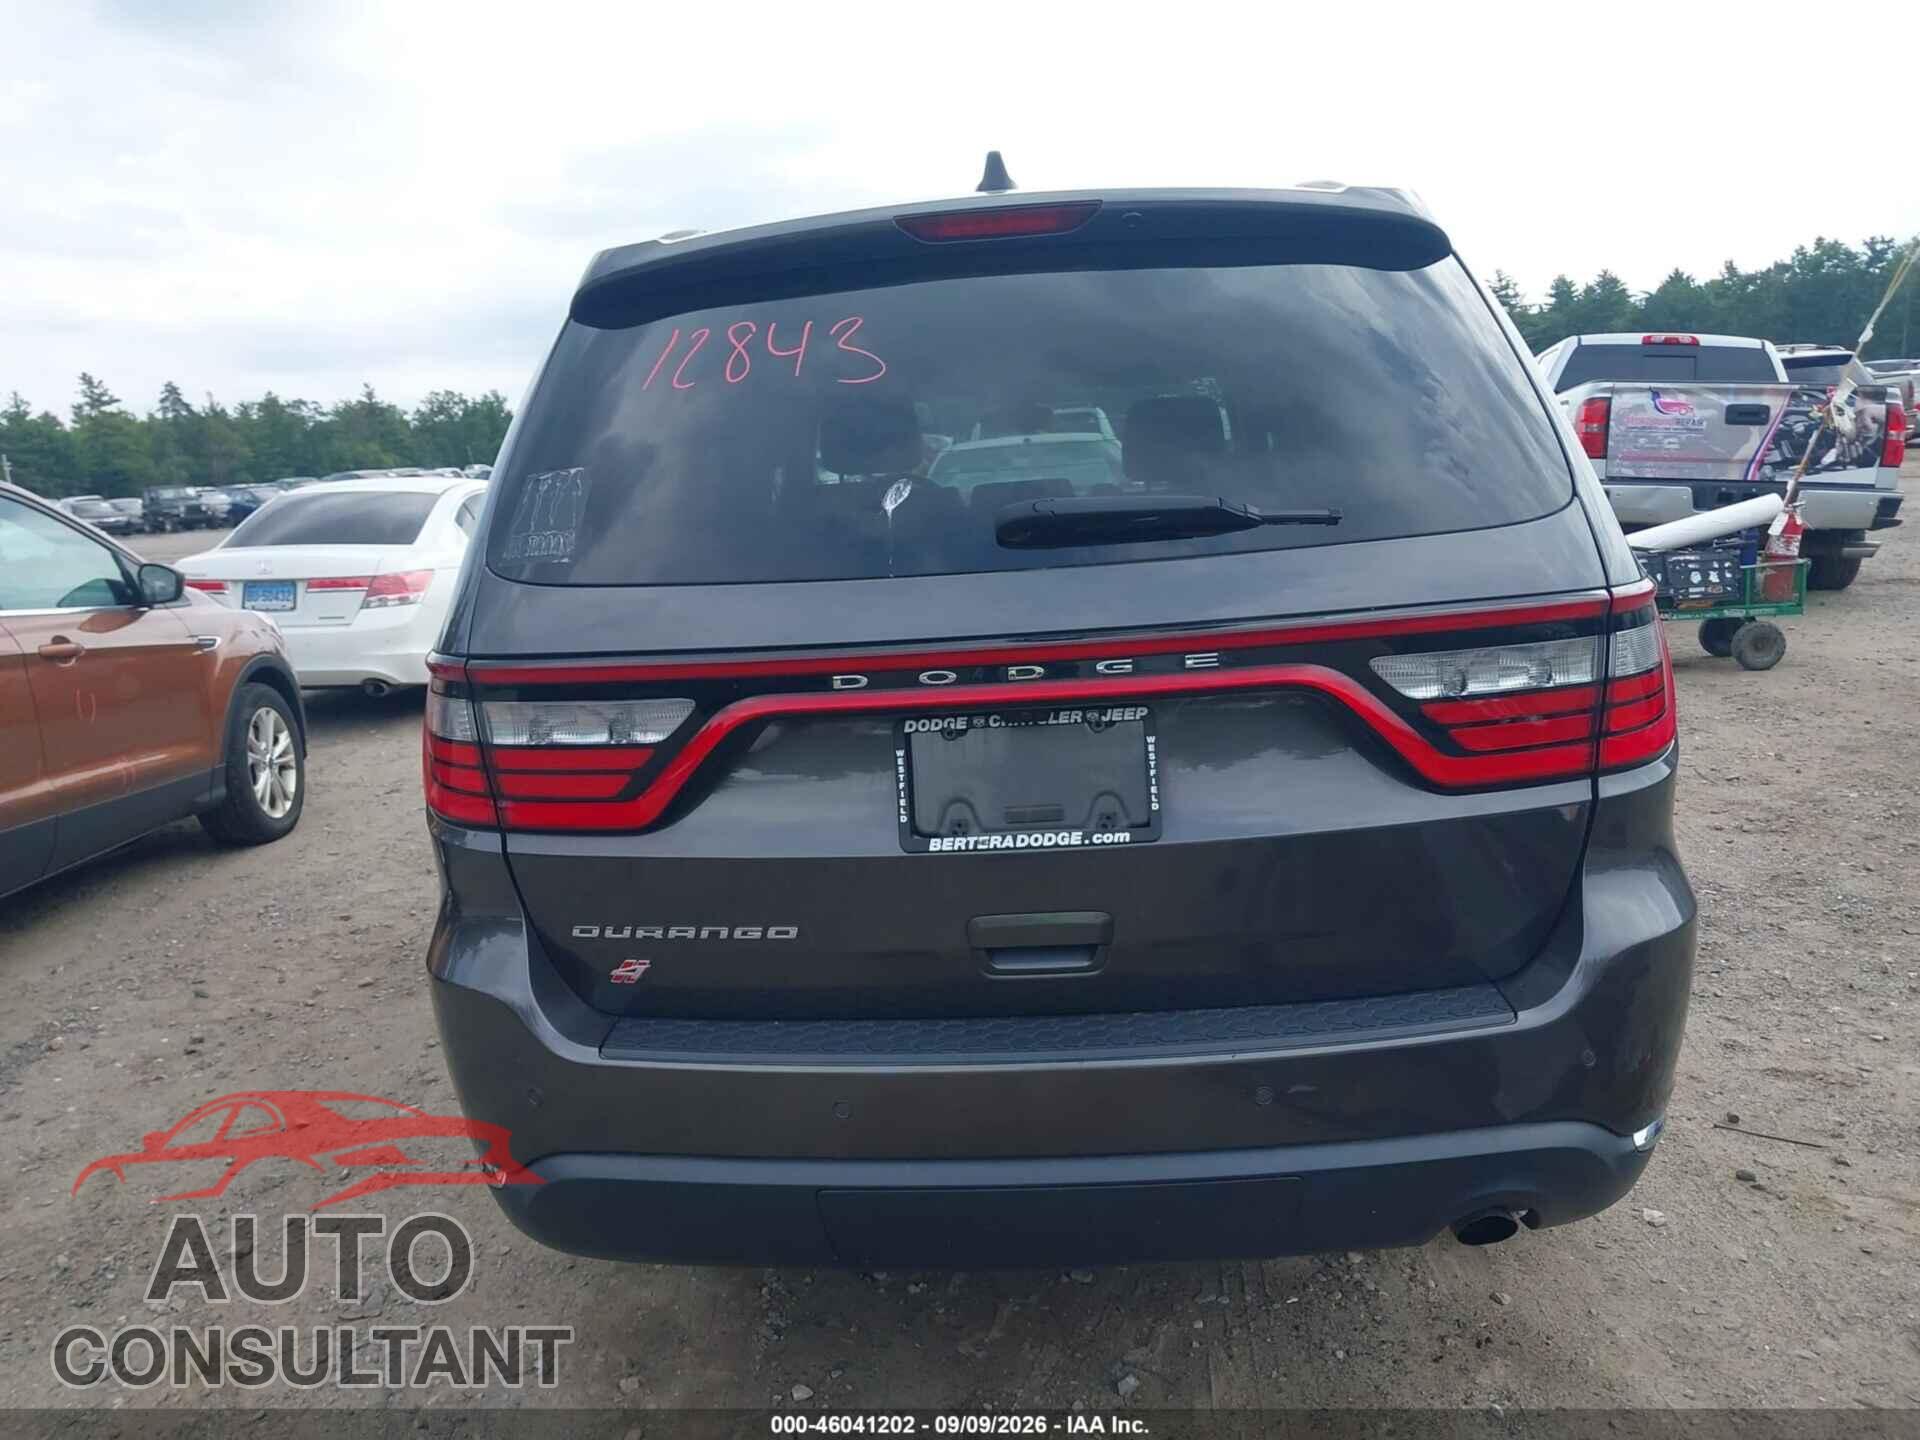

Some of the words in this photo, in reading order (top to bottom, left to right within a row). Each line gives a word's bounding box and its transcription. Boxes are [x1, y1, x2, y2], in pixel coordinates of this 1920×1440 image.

[642, 316, 887, 390] 12843
[832, 652, 1220, 690] DODGE
[1100, 707, 1149, 723] JEEP
[895, 749, 908, 823] WESTFIELD
[1146, 735, 1160, 811] WESTFIELD
[571, 925, 799, 940] DURANGO
